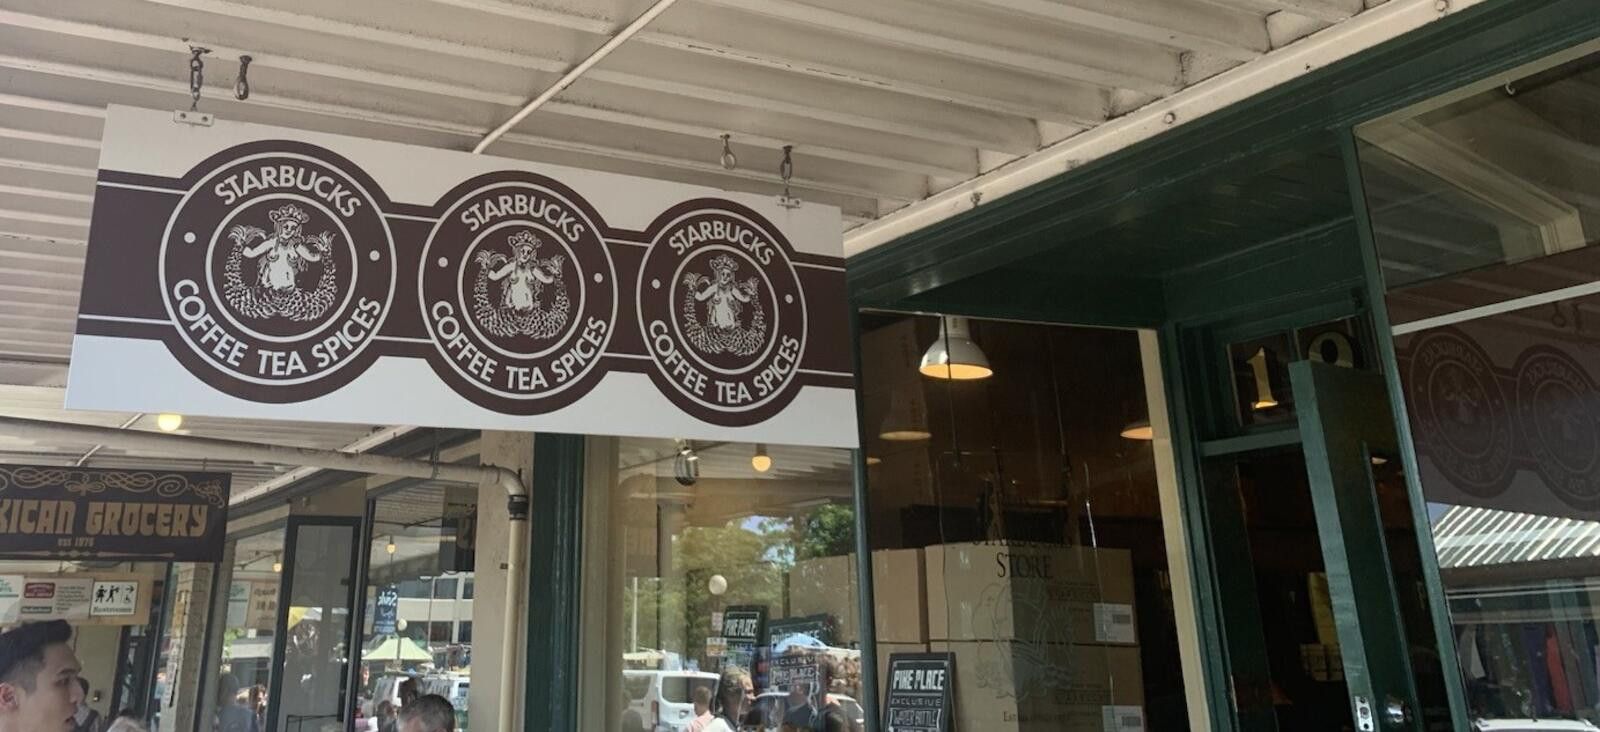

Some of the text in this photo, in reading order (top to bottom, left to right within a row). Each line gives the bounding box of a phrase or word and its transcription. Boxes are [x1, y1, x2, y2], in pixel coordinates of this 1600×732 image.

[214, 165, 362, 218] STARBUCKS
[461, 193, 585, 243] STARBUCKS
[668, 220, 775, 266] STARBUCKS
[173, 279, 382, 376] COFFEE TEA SPICES
[432, 300, 607, 391] COFFEE TEA SPICES
[649, 319, 800, 405] COFFEE TEA SPICES
[86, 502, 208, 537] GROCERY
[996, 552, 1054, 578] STORE
[893, 670, 945, 691] PIKE PLACE
